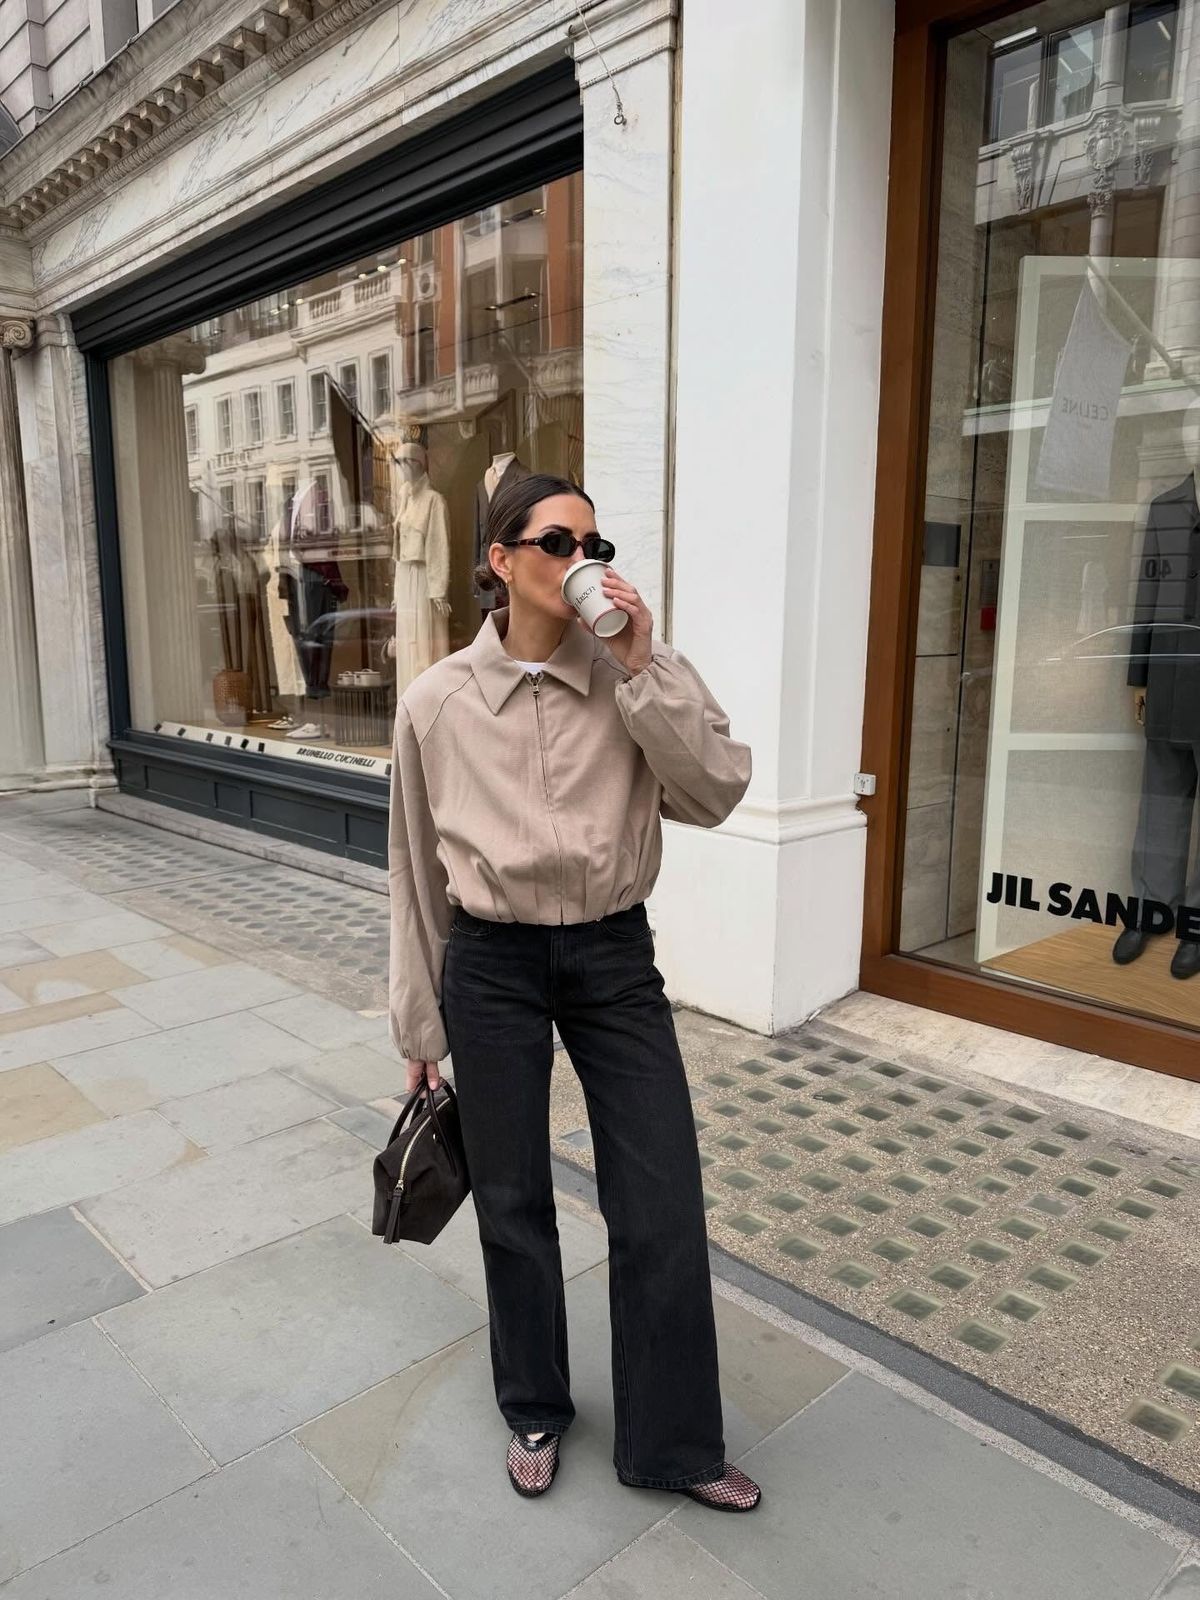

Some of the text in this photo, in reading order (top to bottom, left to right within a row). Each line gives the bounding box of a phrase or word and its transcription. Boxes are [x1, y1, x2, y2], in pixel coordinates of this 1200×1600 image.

[296, 747, 377, 768] BRUNELLO CUCINELLI
[986, 872, 1040, 911] JIL
